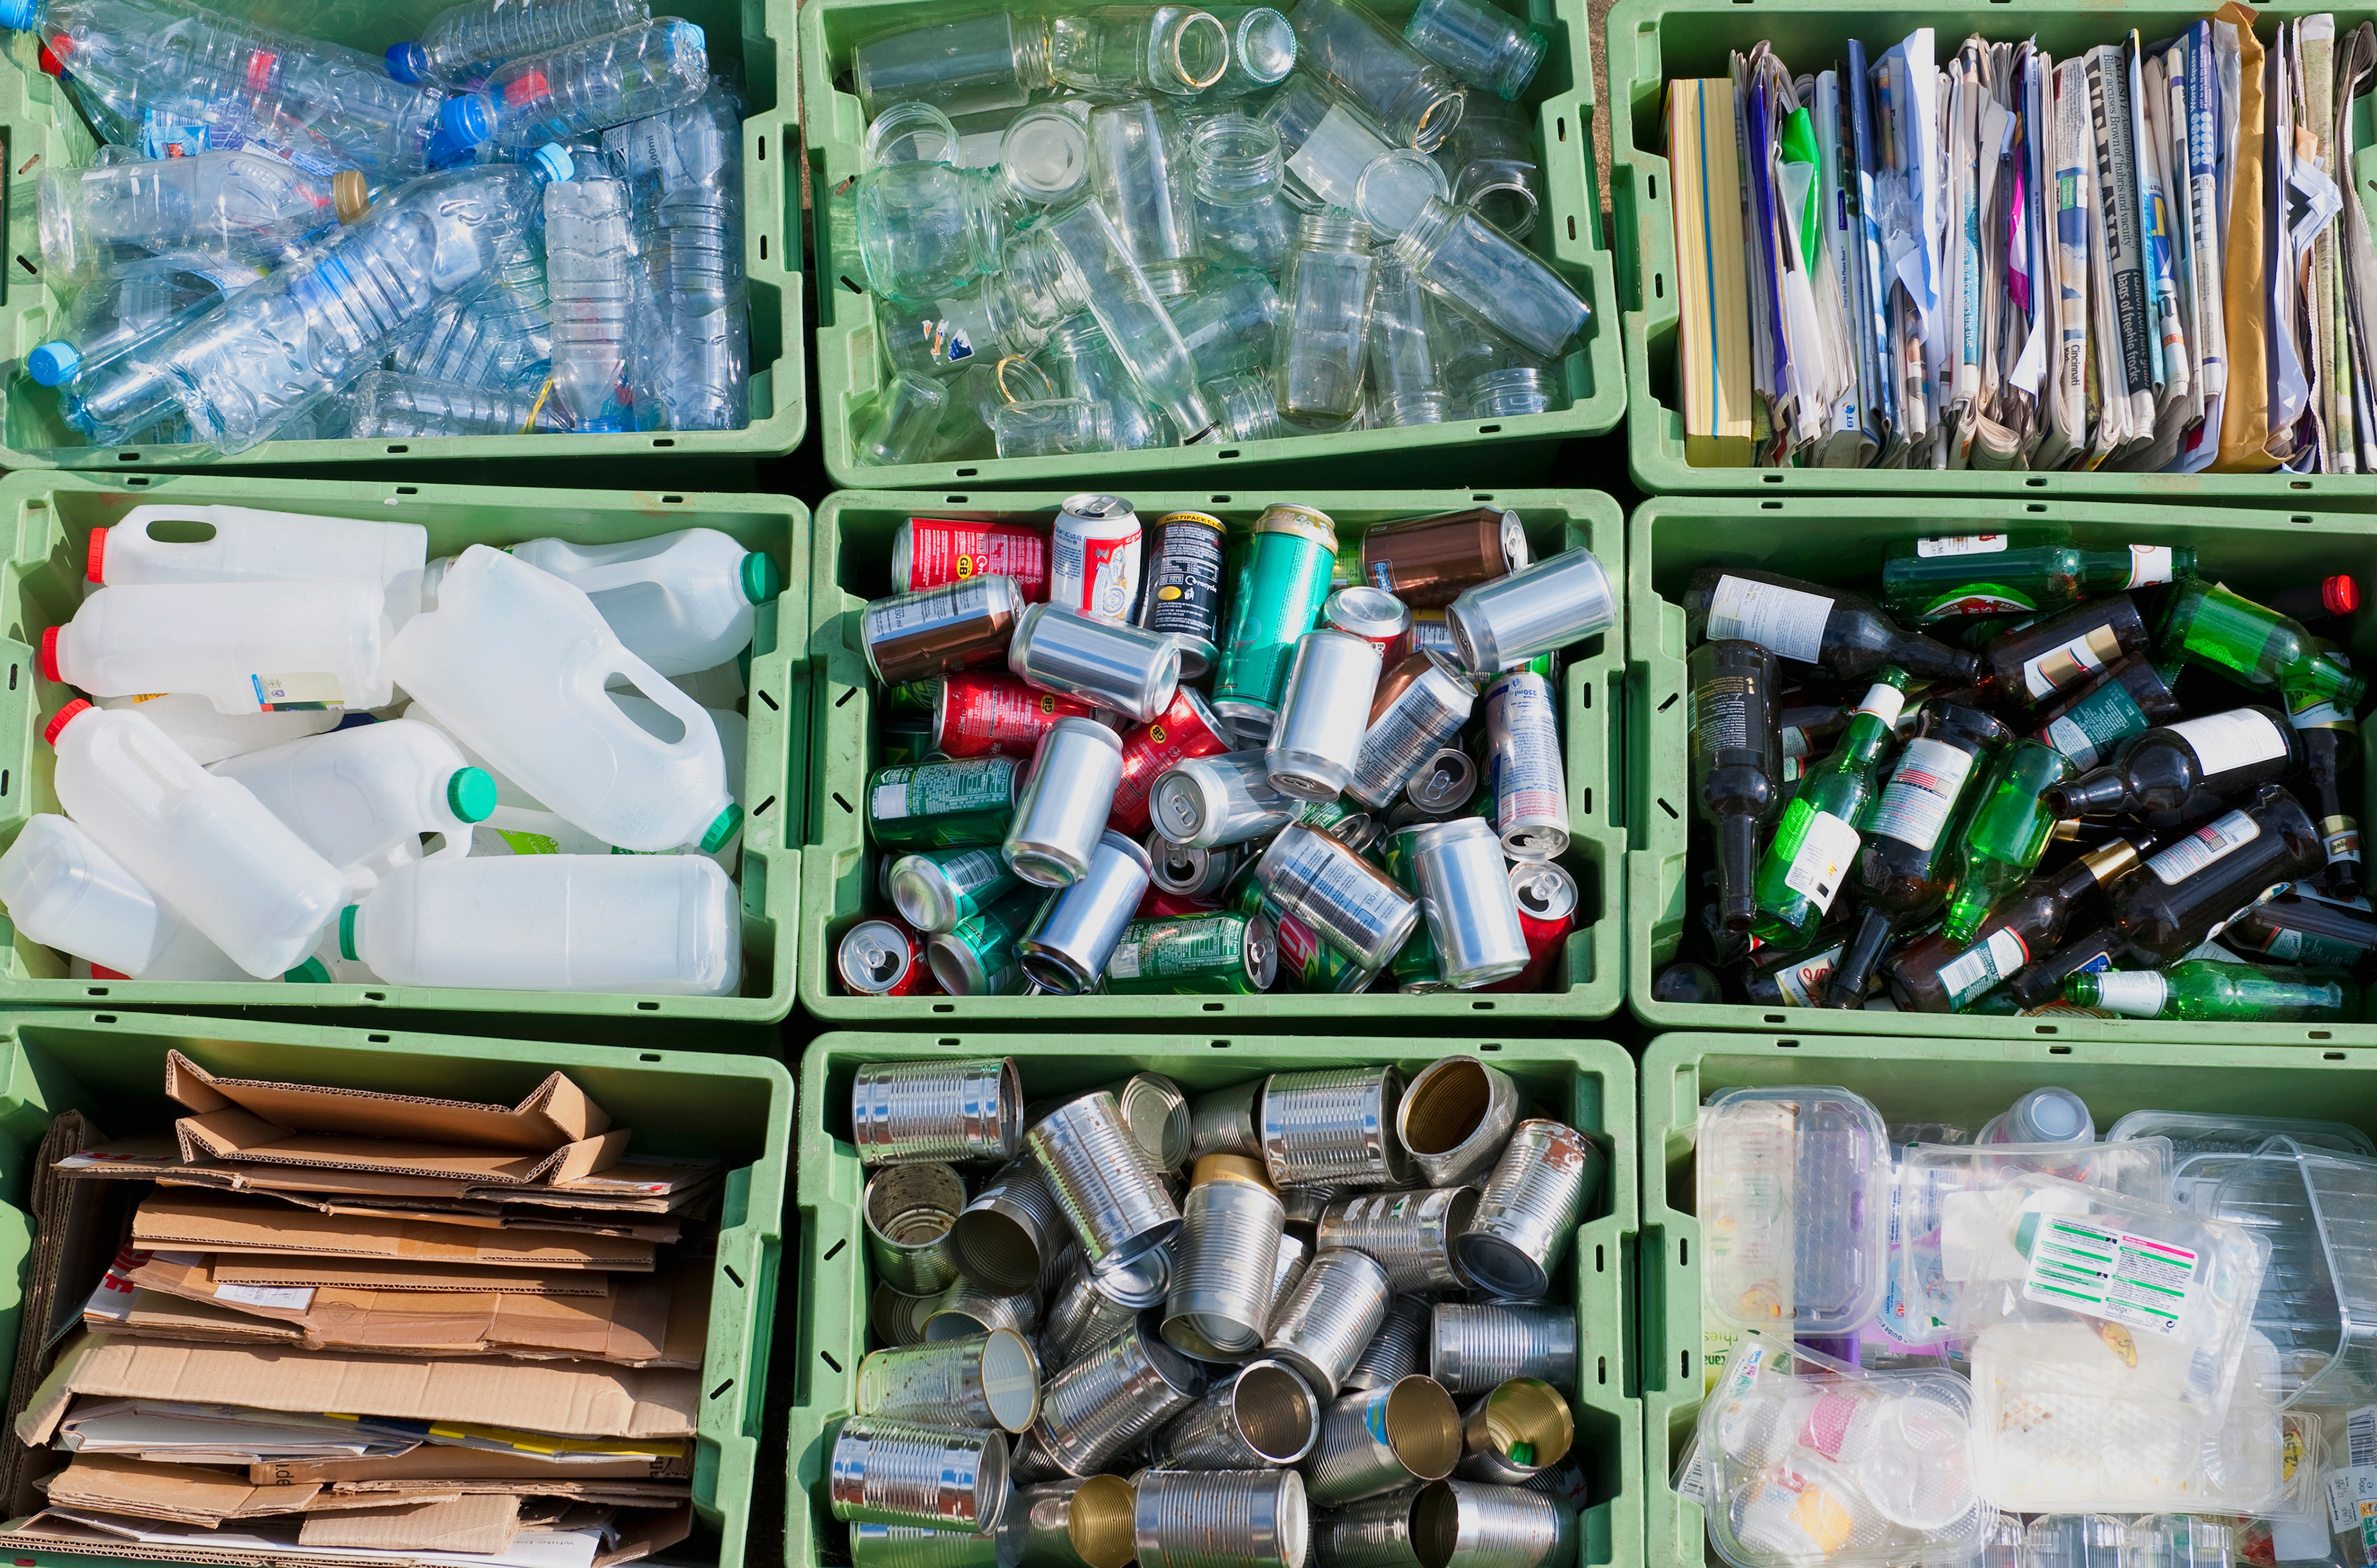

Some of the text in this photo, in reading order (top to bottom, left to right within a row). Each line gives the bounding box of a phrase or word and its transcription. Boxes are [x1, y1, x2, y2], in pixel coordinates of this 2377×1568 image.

[2104, 54, 2114, 77] Blair
[2114, 55, 2127, 115] EXCLUSIVE:
[2106, 78, 2118, 114] accuses
[2109, 116, 2121, 146] Brown
[646, 135, 661, 166] 500ml
[2121, 115, 2134, 169] Astonishing
[2113, 148, 2123, 157] of
[2127, 171, 2135, 198] secret
[2118, 194, 2130, 212] and
[1963, 280, 1972, 291] for
[2117, 272, 2130, 300] bags
[1963, 291, 1972, 314] years
[2120, 300, 2134, 311] of
[1964, 315, 1973, 329] the
[1965, 330, 1974, 348] true
[2071, 345, 2080, 386] Cincinnati
[2126, 350, 2140, 384] frocks
[1846, 415, 1854, 428] BT
[959, 557, 968, 575] GB
[1197, 580, 1217, 593] recycle
[1044, 697, 1053, 713] GB
[1152, 726, 1165, 741] GB
[1365, 896, 1376, 906] 330
[1792, 988, 1802, 1000] BEER
[2121, 1247, 2141, 1256] Ingredients
[2106, 1302, 2125, 1314] 300g
[2107, 1297, 2146, 1311] Additional information
[1884, 1327, 1903, 1342] GUIDE
[2358, 1477, 2367, 1495] 300g
